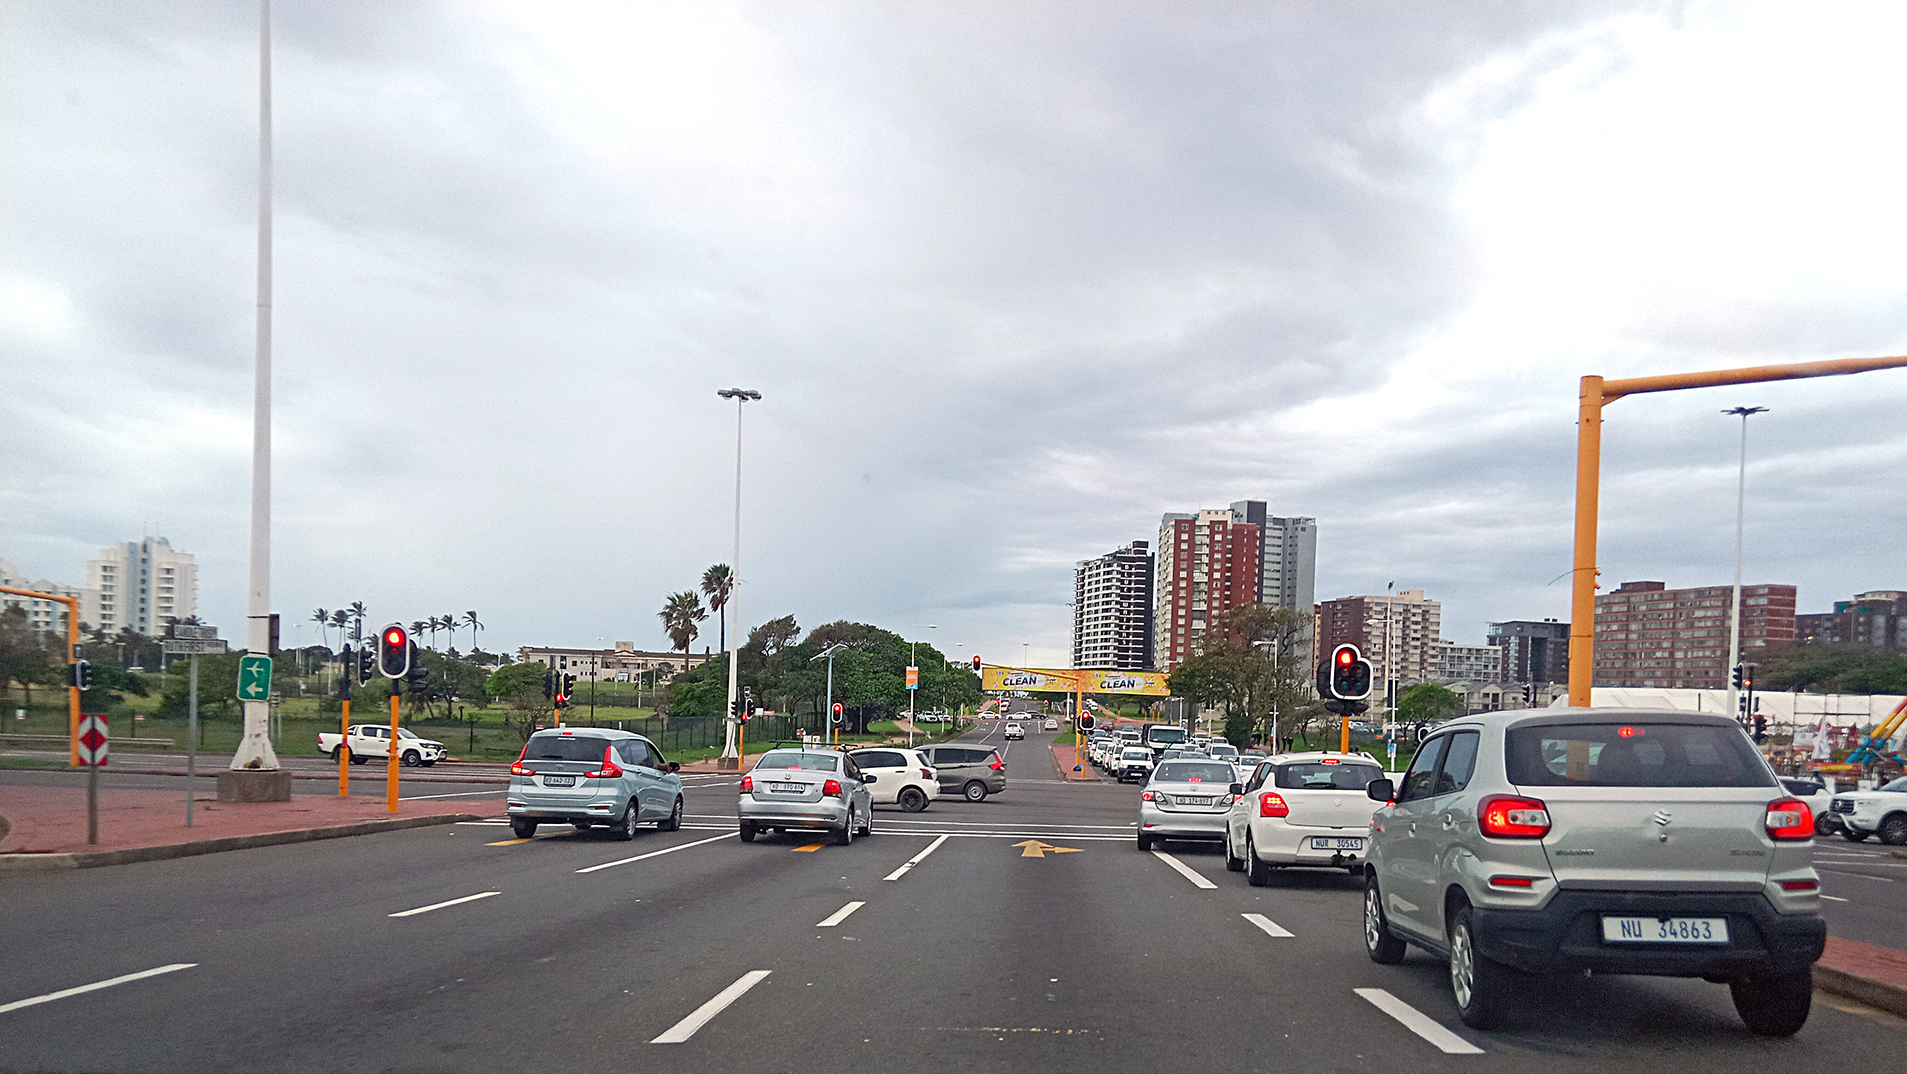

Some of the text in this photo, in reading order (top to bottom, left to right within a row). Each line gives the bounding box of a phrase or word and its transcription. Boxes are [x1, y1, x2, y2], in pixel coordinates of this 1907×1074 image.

[1003, 676, 1037, 686] CLEAN
[1100, 680, 1135, 689] CLEAN
[1337, 840, 1359, 848] 30545
[1621, 920, 1711, 939] NU 34863
